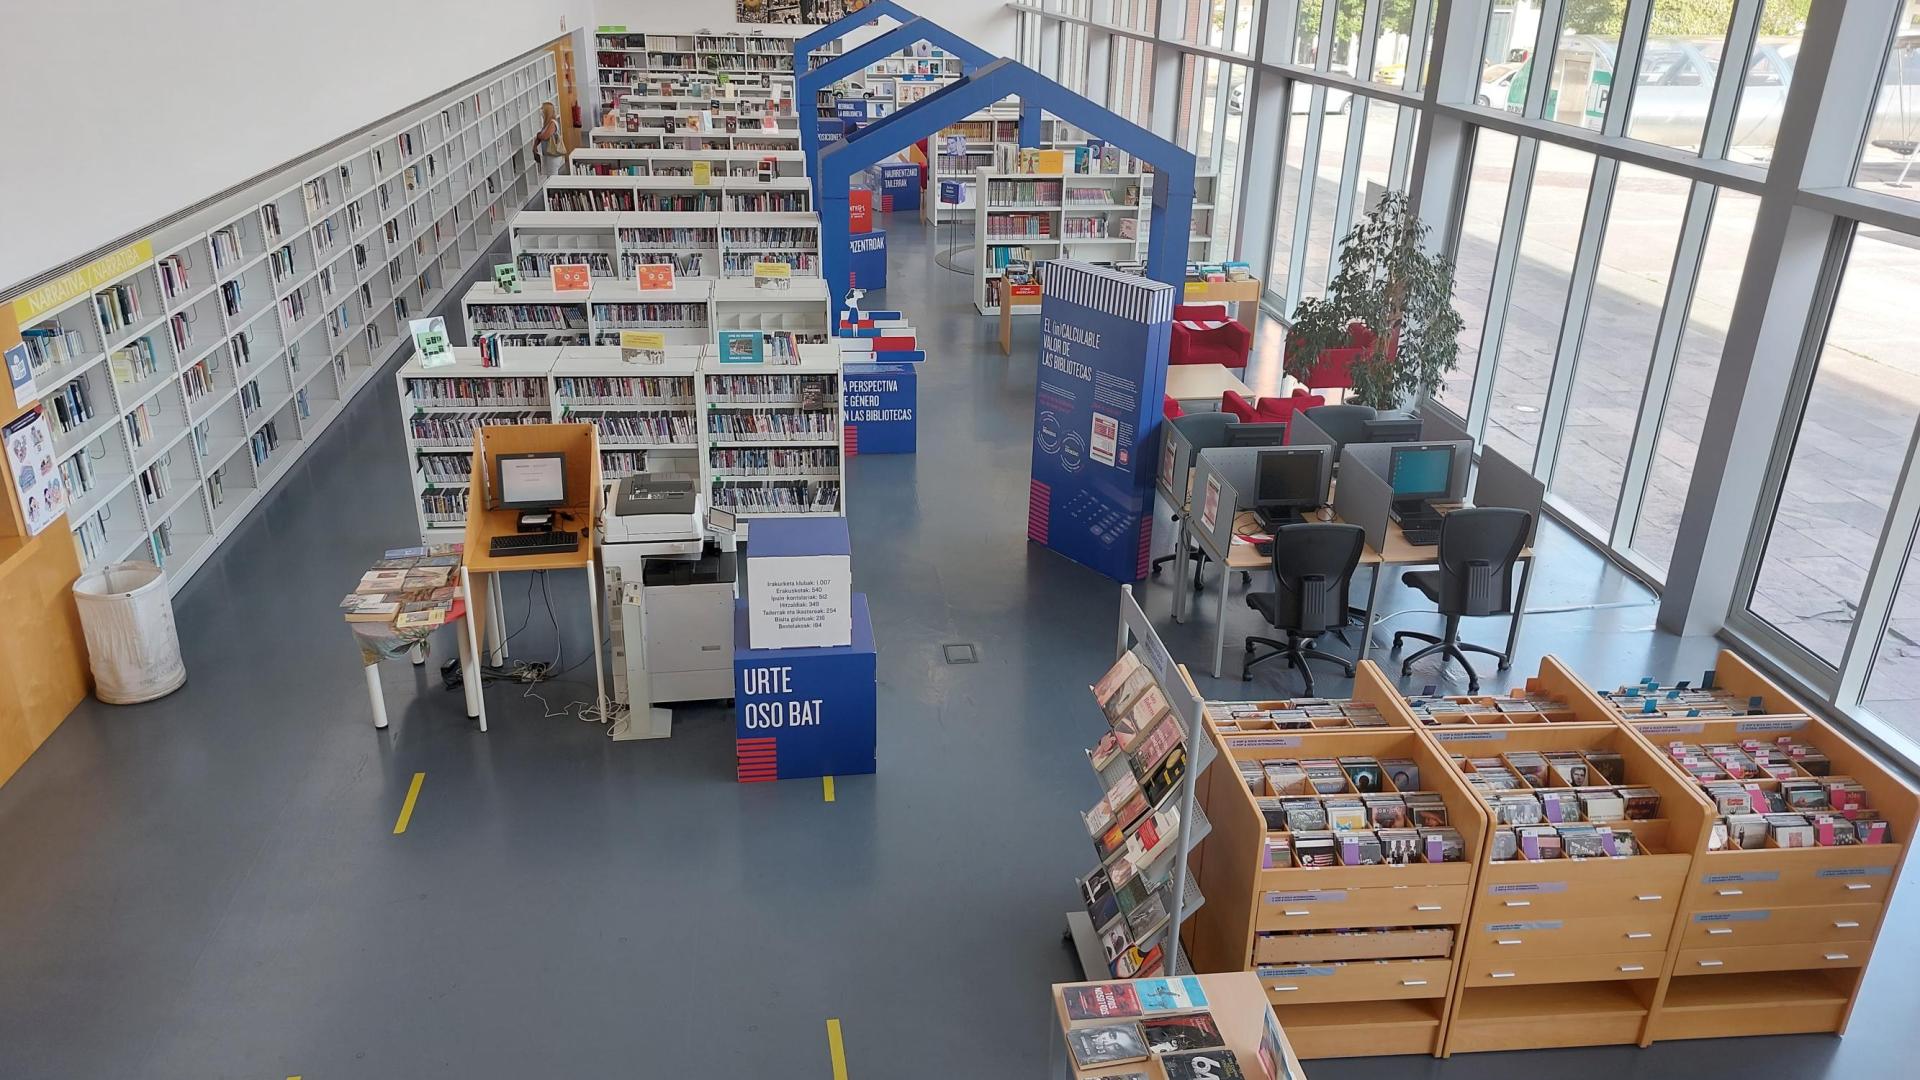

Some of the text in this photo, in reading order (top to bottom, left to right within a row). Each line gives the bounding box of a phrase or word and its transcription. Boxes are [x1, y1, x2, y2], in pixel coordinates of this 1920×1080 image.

[28, 271, 86, 314] NARRATIVA
[1044, 317, 1051, 333] EL
[1043, 333, 1071, 357] VALOR DE
[1042, 350, 1093, 382] LAS BIBLIOTECAS
[849, 380, 898, 392] PERSPECTIVA
[850, 393, 880, 407] GÉNERO
[850, 410, 865, 421] LAS
[865, 409, 912, 421] BIBLIOTECAS
[744, 667, 793, 695] URTE
[745, 700, 823, 729] OSO BAT
